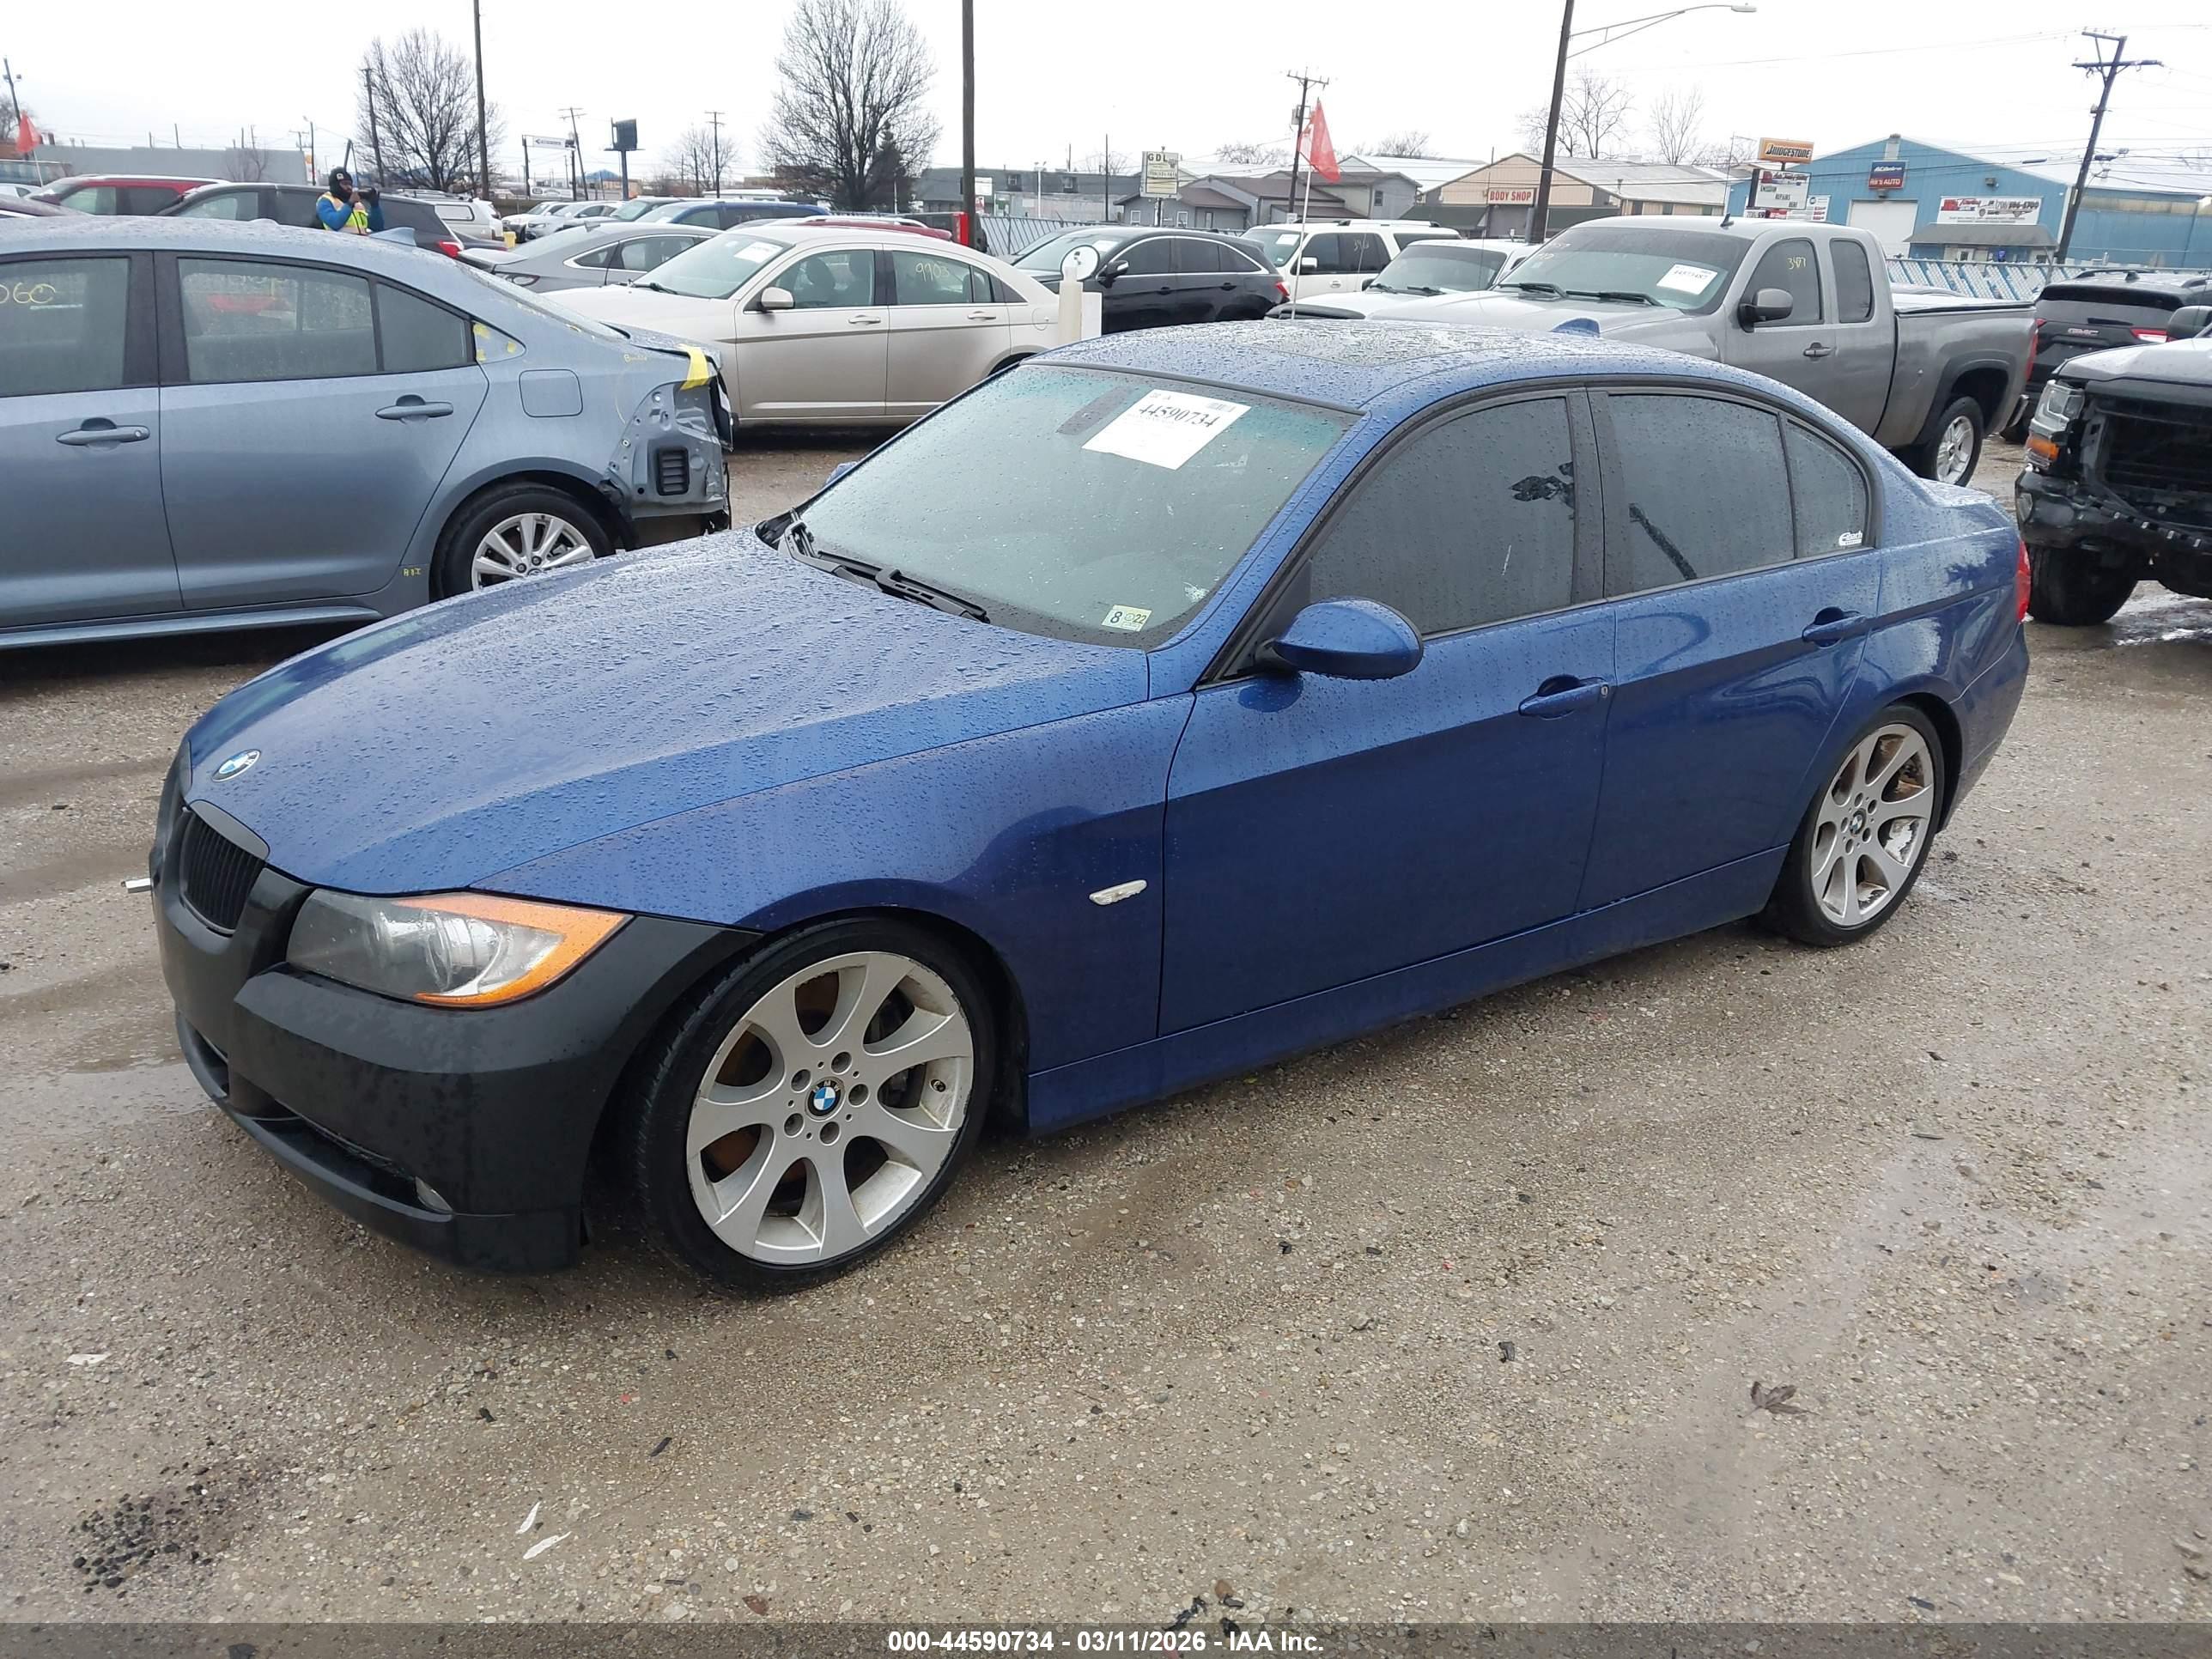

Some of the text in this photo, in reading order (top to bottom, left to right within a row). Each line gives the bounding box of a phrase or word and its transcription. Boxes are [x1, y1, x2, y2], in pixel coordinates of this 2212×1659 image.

[1765, 143, 1811, 158] BRIDGESTONE
[1148, 153, 1168, 162] GDL
[1490, 191, 1531, 201] BODY SHOP
[2067, 327, 2099, 336] GMC
[1139, 404, 1220, 428] 44590734
[1110, 611, 1146, 624] 8 22
